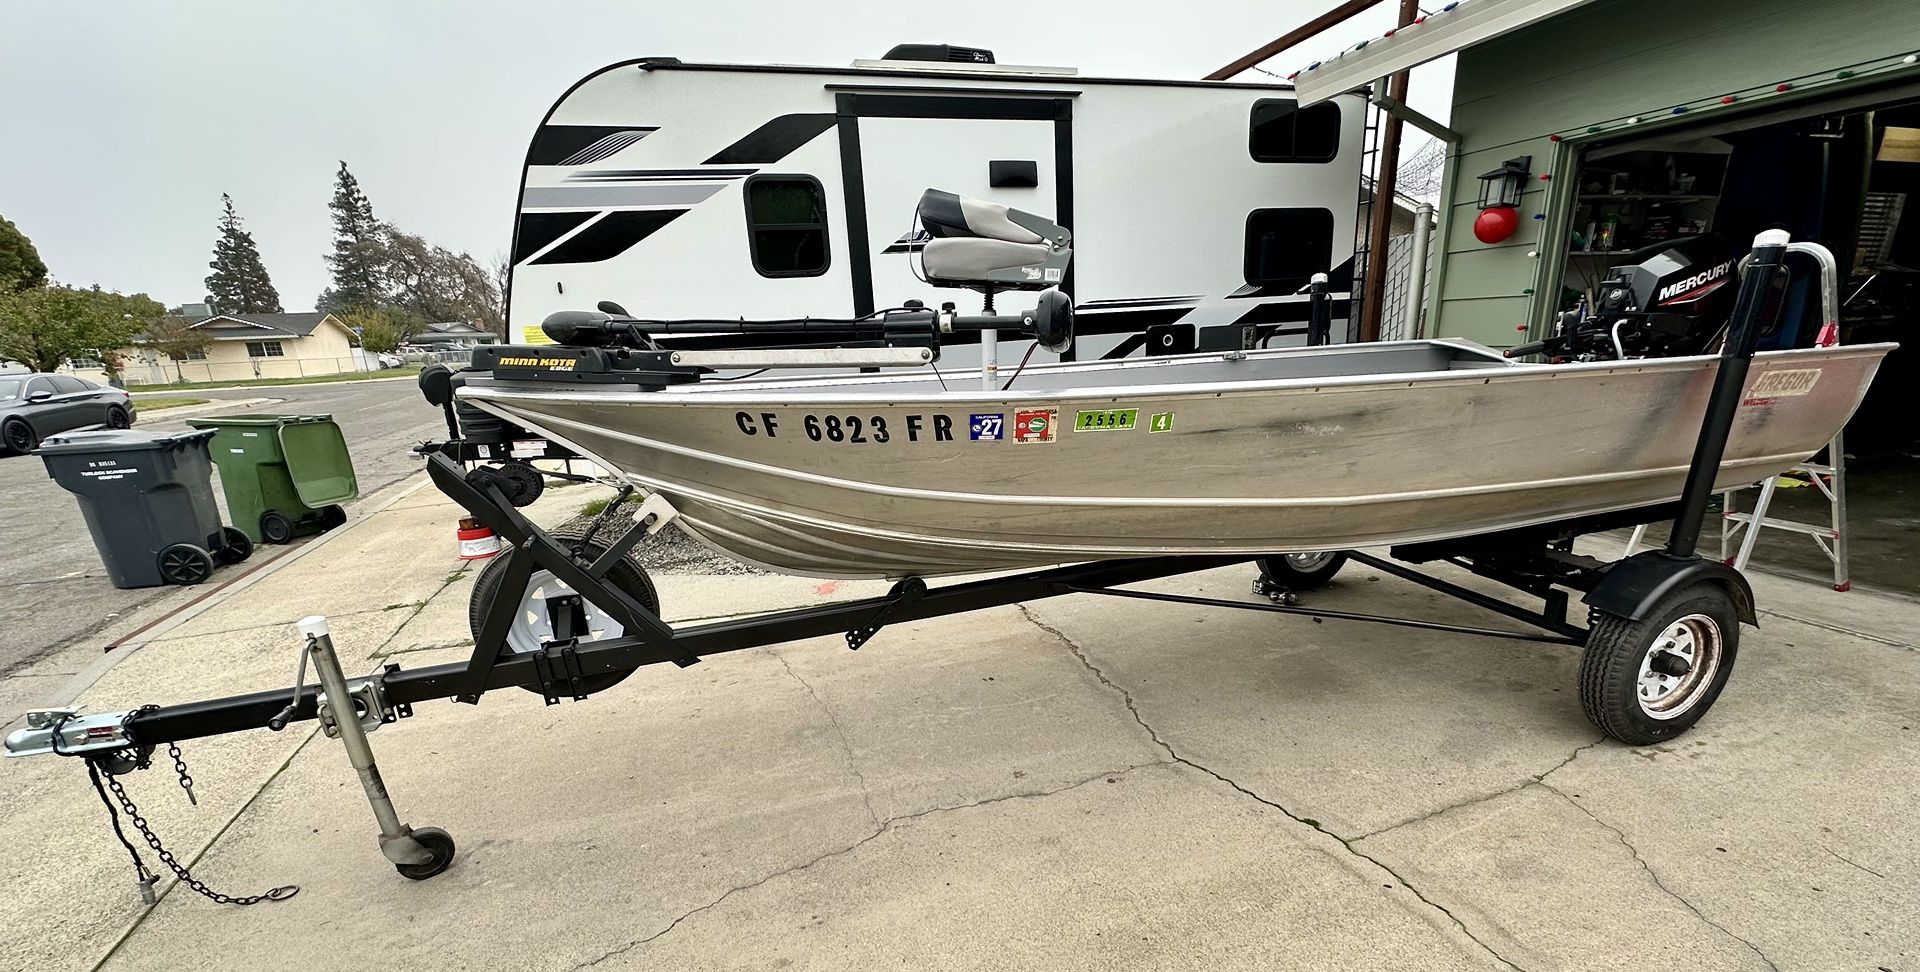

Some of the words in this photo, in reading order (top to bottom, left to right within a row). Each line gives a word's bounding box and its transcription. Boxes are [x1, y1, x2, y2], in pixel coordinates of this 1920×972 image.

[1658, 260, 1732, 301] MERCURY
[499, 357, 538, 366] MINN
[539, 358, 576, 367] KOTA
[735, 411, 779, 438] CF
[803, 414, 890, 443] 6823
[905, 414, 954, 442] FR
[981, 419, 1003, 436] 27
[1084, 413, 1128, 427] 2556
[1156, 415, 1167, 430] 4
